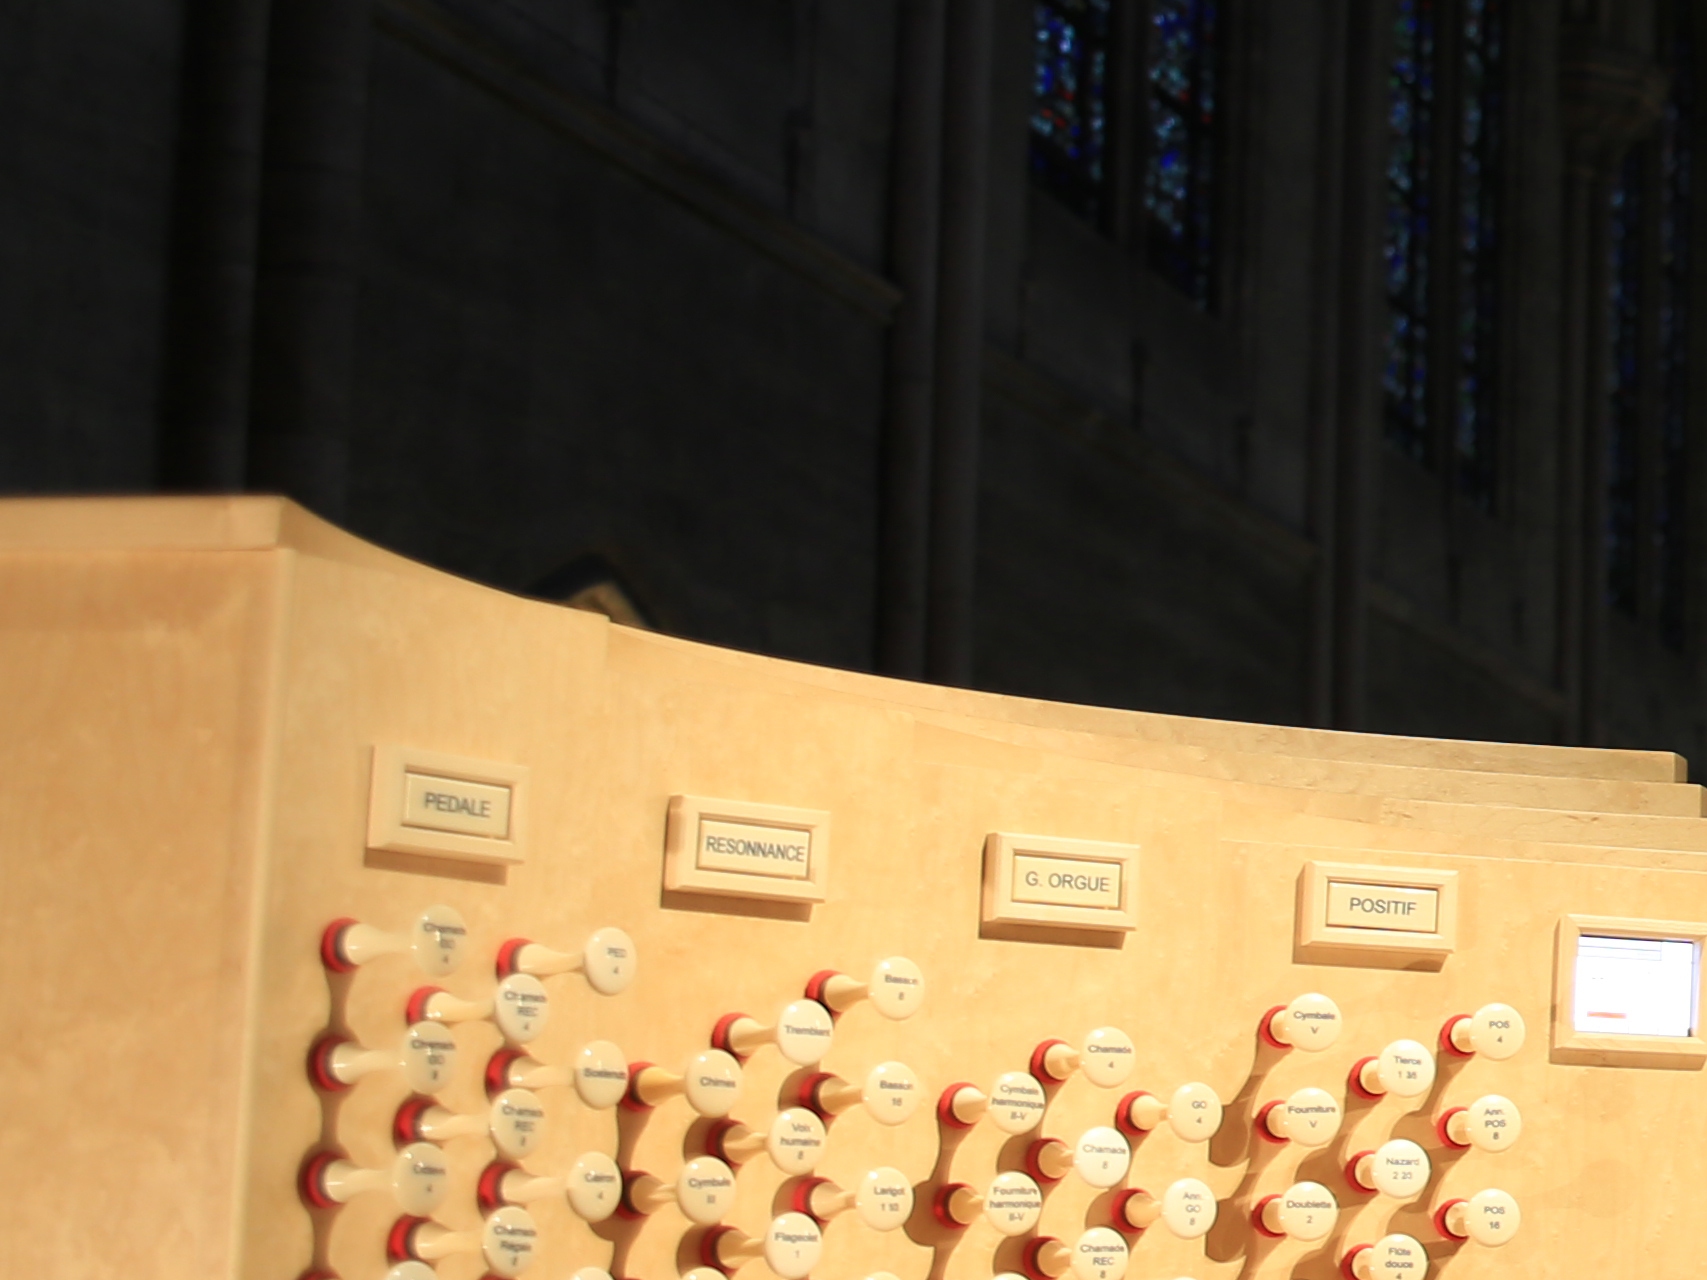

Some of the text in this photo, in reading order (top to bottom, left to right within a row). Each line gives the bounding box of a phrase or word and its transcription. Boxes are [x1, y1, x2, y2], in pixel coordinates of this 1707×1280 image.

[422, 790, 491, 819] PEDALE
[705, 835, 805, 863] RESONNANCE
[1024, 870, 1110, 893] G. ORGUE
[1349, 896, 1418, 916] POSITIF
